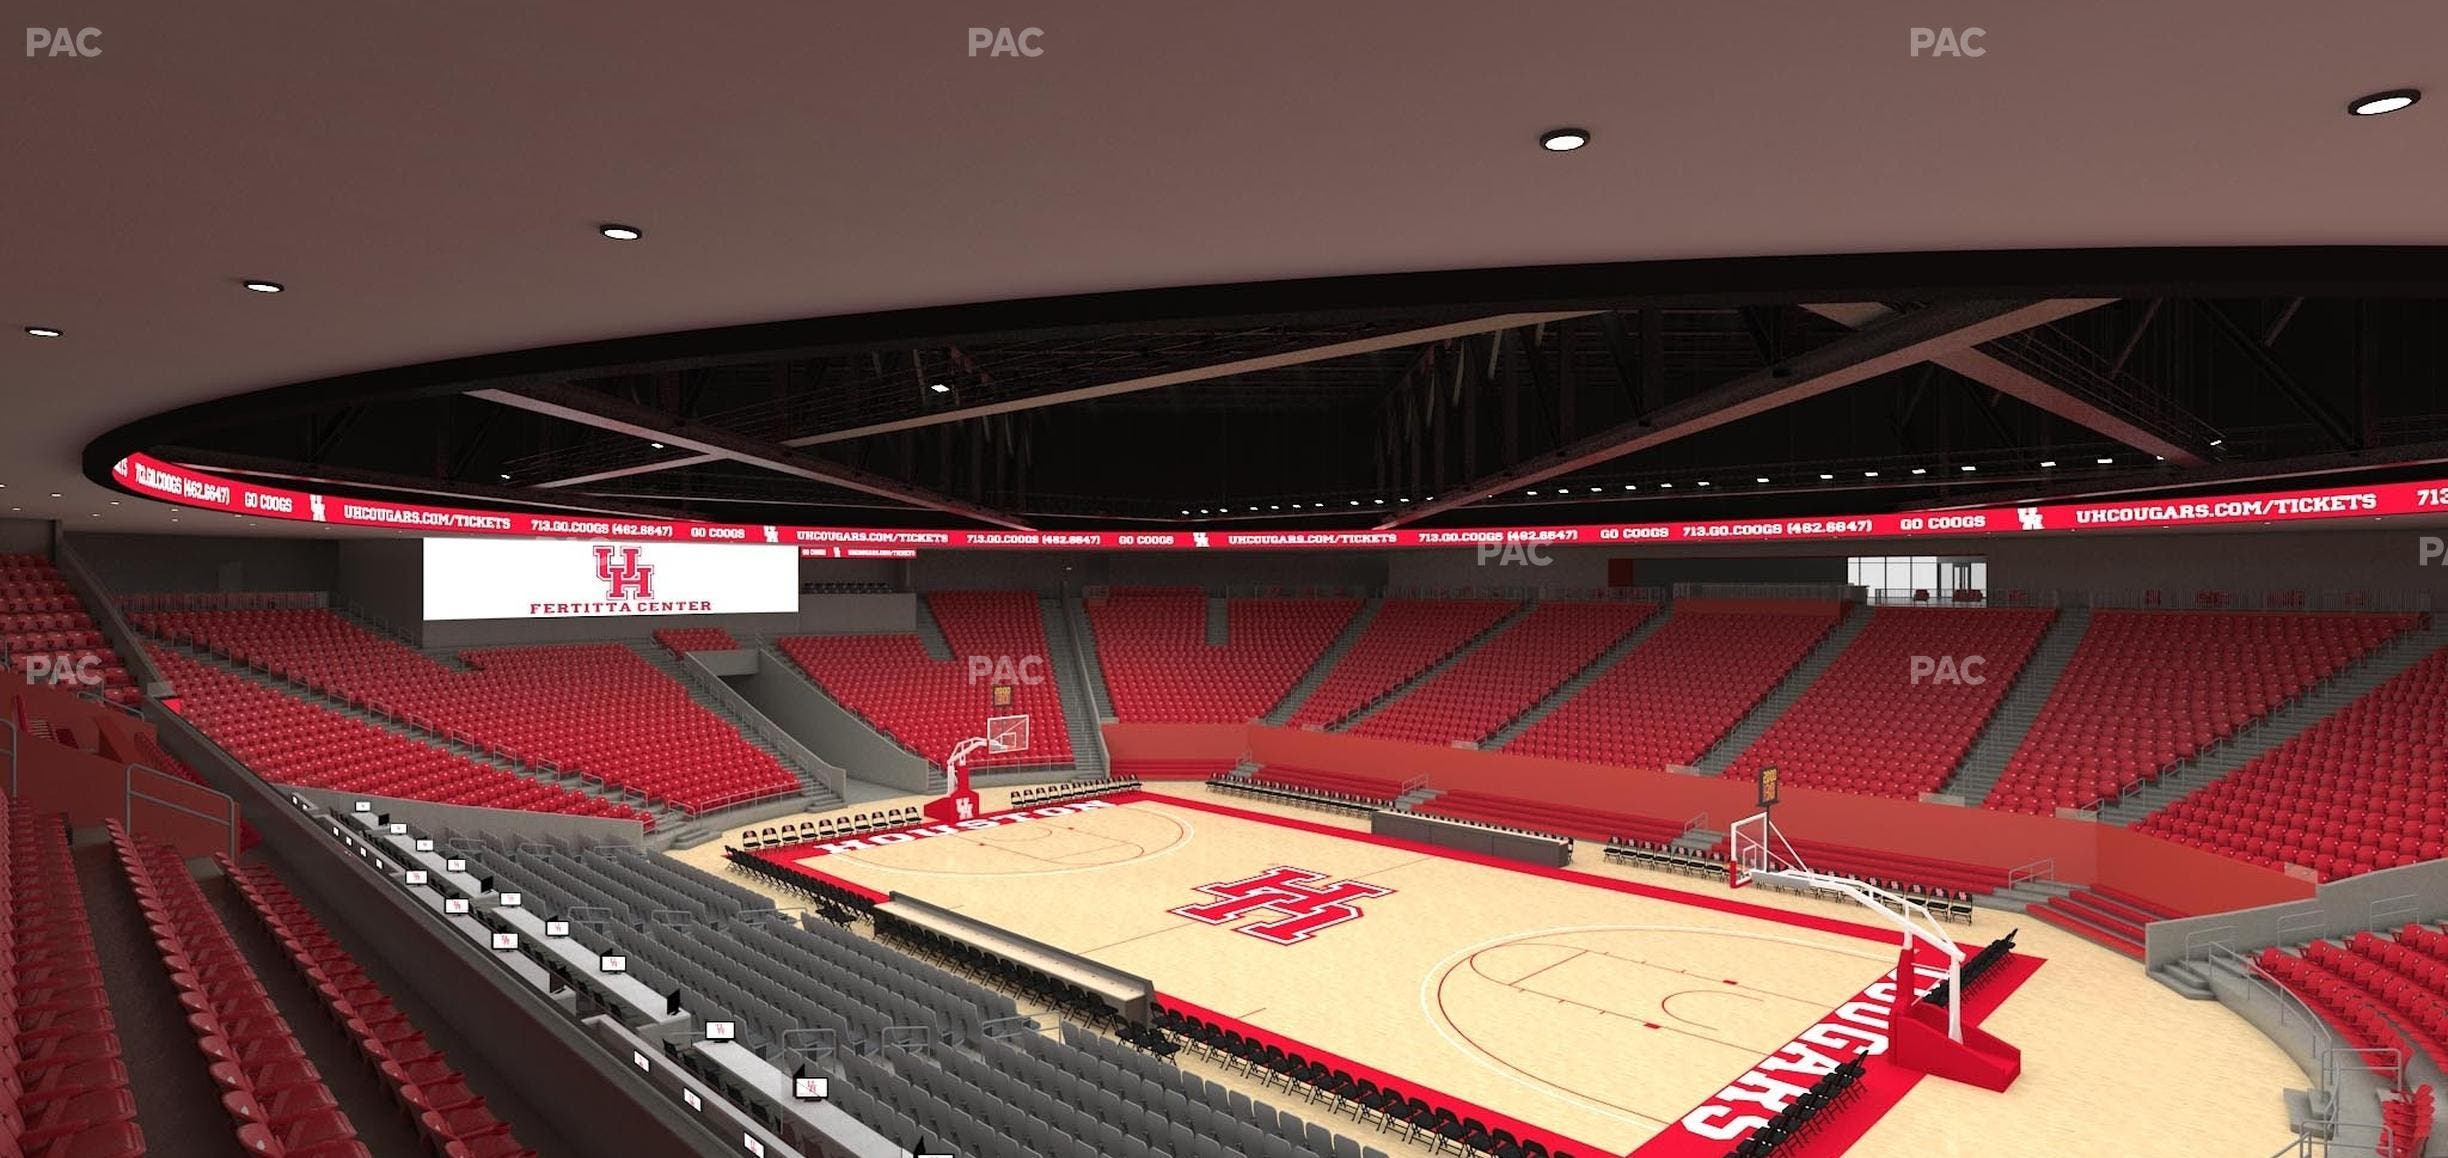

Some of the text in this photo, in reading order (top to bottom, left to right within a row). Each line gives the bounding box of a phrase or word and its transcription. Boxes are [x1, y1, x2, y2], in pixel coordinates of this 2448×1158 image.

[245, 492, 293, 512] GO COOGS
[2076, 493, 2377, 523] UHCOUGARS.COM/TICKETS
[344, 505, 510, 530] UHCOUGARS.COM/TICKETS
[1900, 515, 1986, 531] GO COOGS
[691, 528, 706, 538] GO
[797, 530, 949, 543] UHCOUGARS.COM/TICKETS
[1600, 527, 1669, 540] GO COOGS
[1683, 522, 1783, 537] 713.GO.COOGS
[1119, 535, 1133, 545] GO
[1228, 533, 1397, 545] UHCOUGARS.COM/TICKETS
[593, 545, 654, 600] UH
[530, 601, 712, 614] FERTITTA CENTER
[814, 800, 1118, 854] HOUSTON
